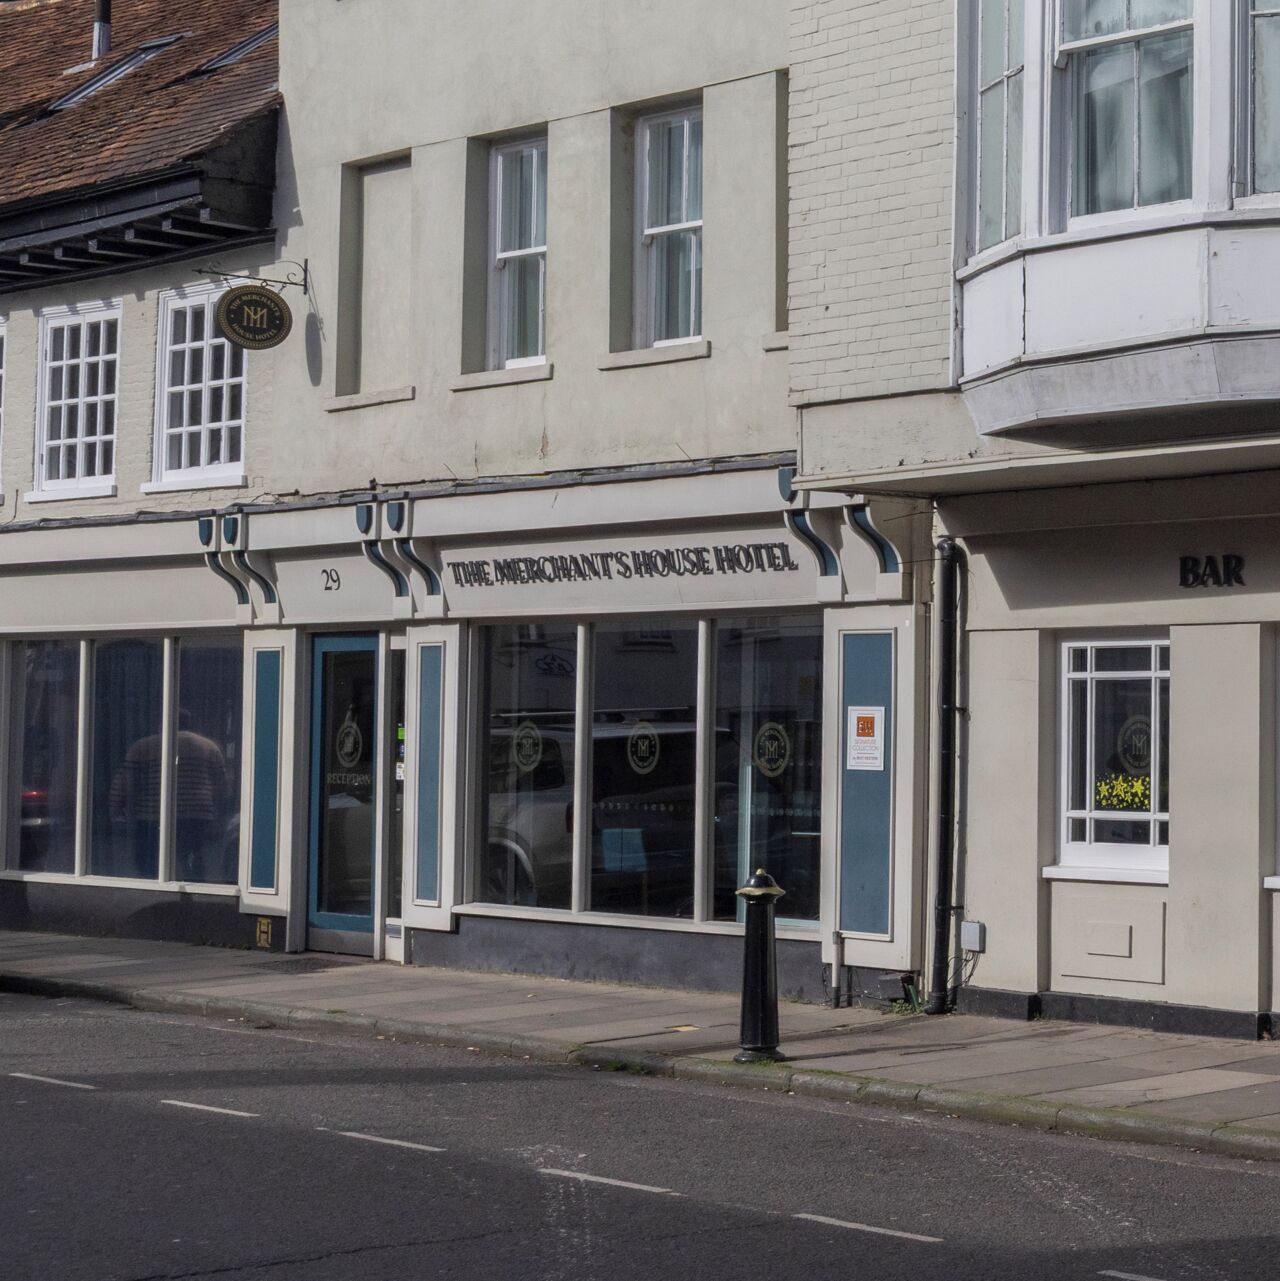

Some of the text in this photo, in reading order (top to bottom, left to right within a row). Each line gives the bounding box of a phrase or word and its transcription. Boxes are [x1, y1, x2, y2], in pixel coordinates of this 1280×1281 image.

[447, 542, 799, 588] THE MERCHANT'S HOUSE HOTEL
[1179, 555, 1247, 588] BAR
[321, 568, 341, 591] 29
[327, 772, 371, 785] RECEPTION
